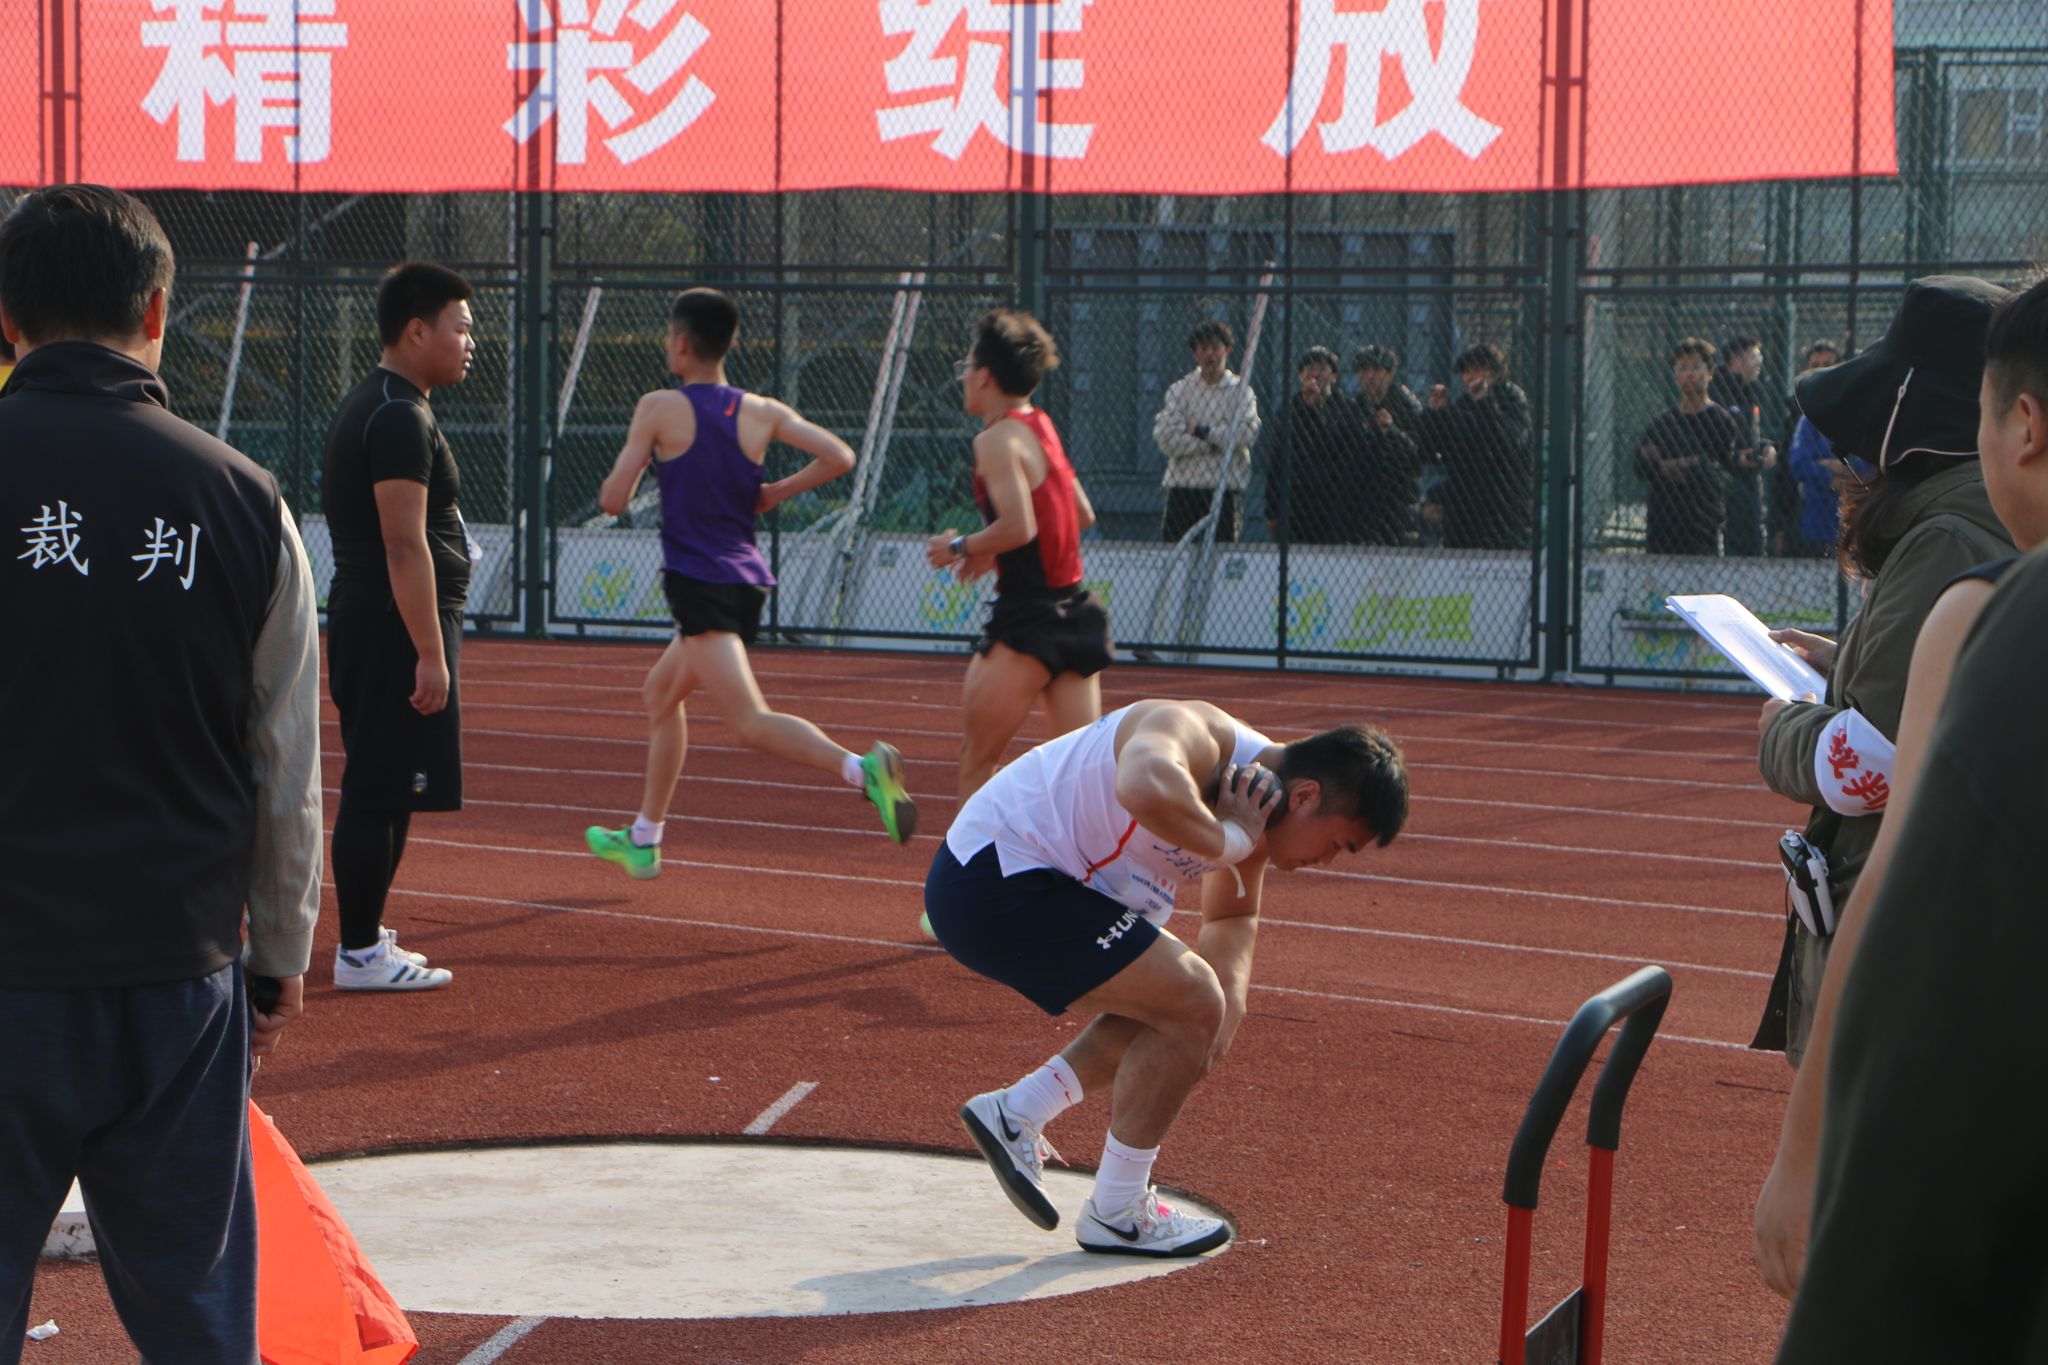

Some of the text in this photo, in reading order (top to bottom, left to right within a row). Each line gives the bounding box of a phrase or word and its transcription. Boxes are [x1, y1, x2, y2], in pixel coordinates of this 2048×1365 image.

[140, 0, 1503, 166] 精彩绽放
[17, 500, 200, 590] 裁判
